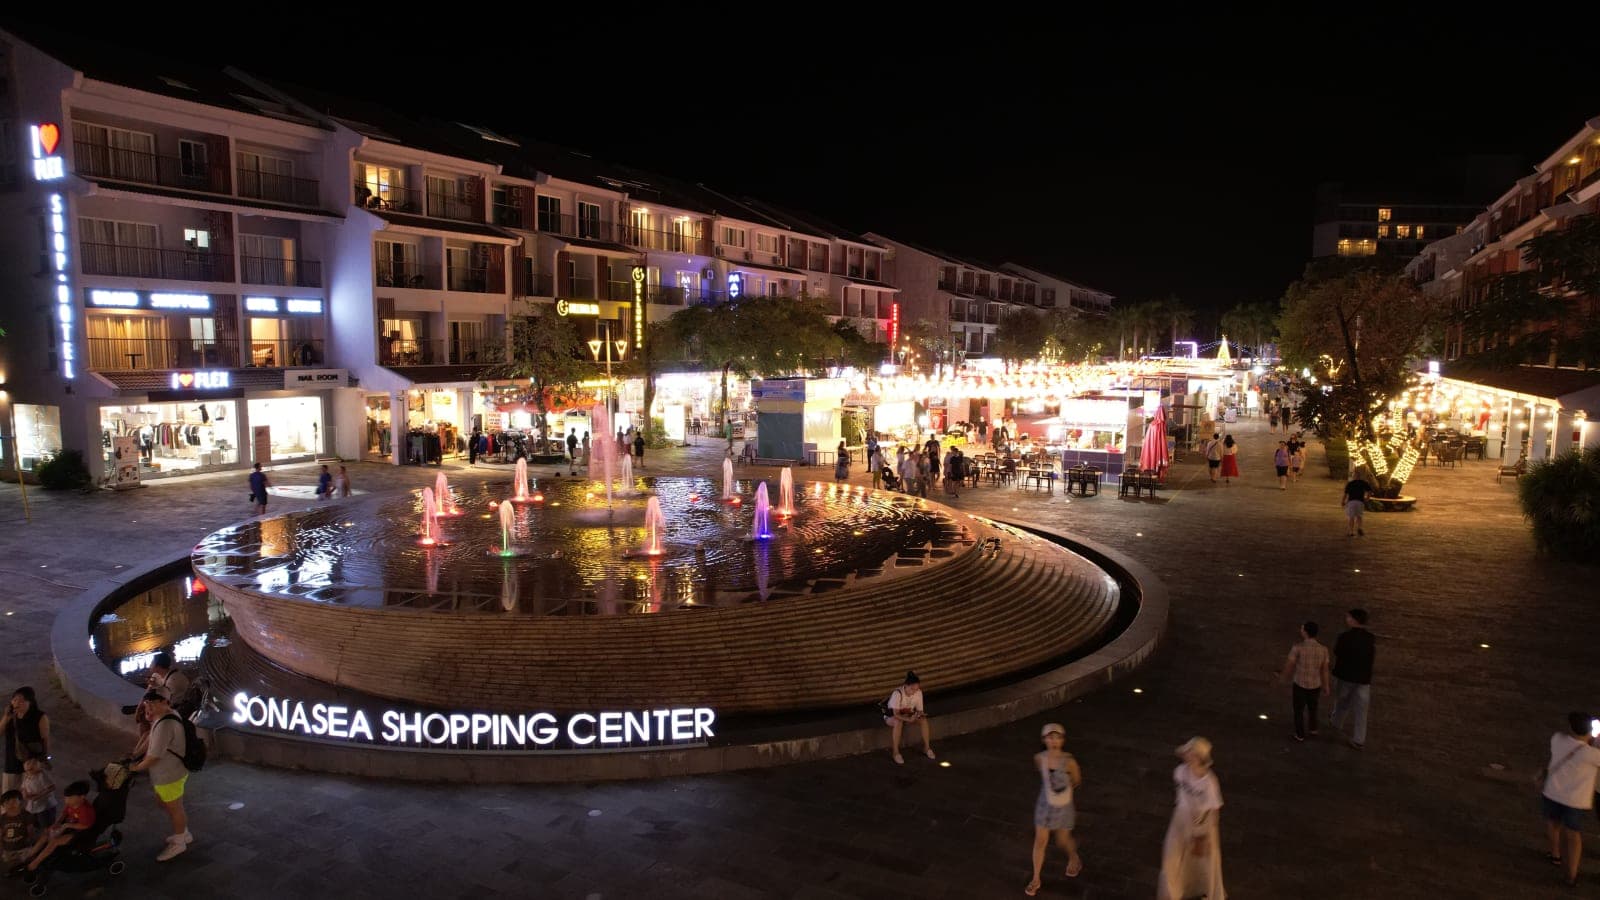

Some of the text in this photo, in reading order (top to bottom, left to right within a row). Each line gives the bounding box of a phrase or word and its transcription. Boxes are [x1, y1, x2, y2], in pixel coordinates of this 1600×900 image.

[31, 125, 41, 158] I
[57, 284, 74, 378] HOTEL
[172, 371, 229, 389] I FLEX
[232, 691, 716, 745] SONASEA SHOPPING CENTER
